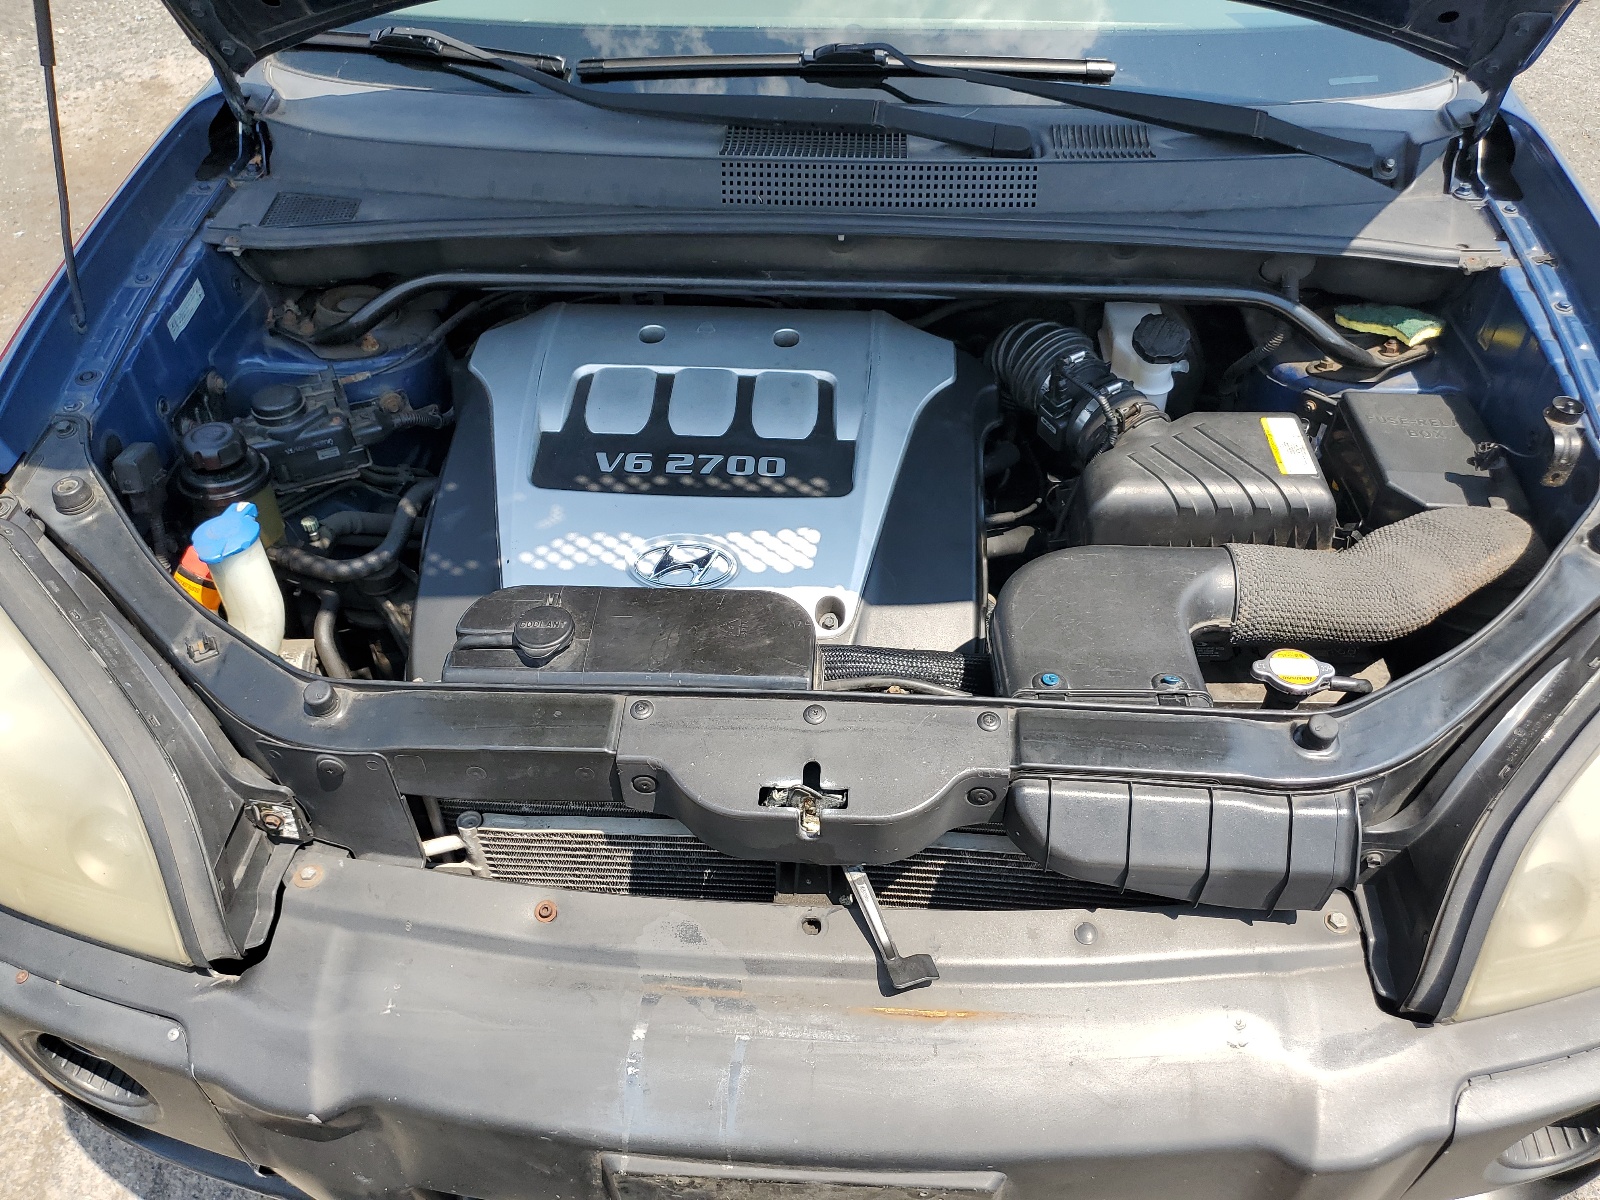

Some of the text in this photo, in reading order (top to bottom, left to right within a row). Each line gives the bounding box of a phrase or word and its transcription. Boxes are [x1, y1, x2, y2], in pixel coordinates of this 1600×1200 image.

[1406, 429, 1445, 439] BOX
[595, 452, 786, 477] V6 2700
[519, 620, 568, 629] COOLANT
